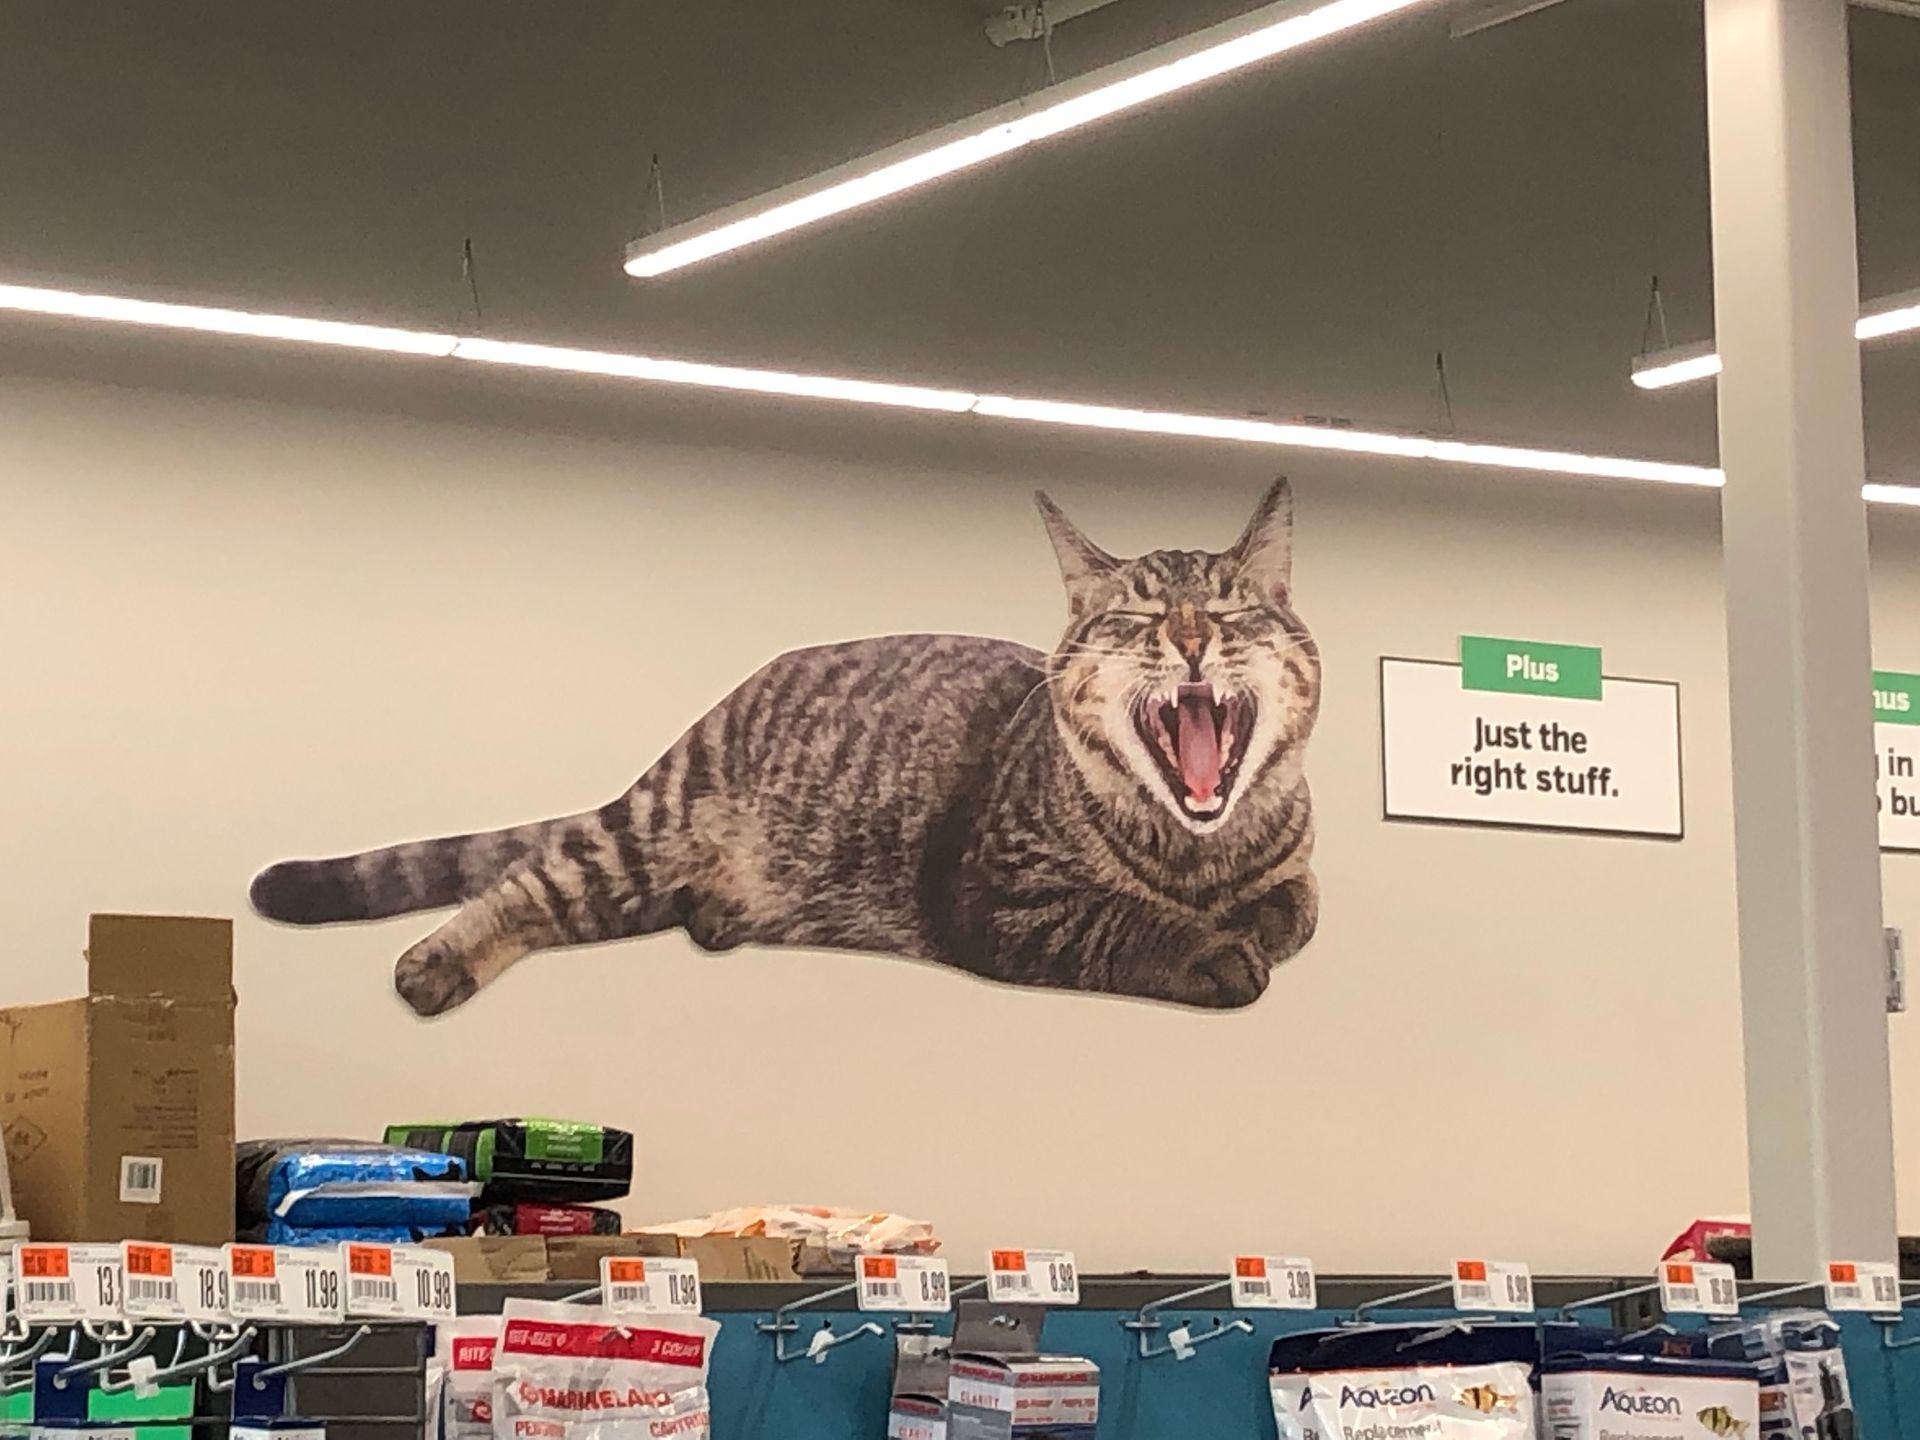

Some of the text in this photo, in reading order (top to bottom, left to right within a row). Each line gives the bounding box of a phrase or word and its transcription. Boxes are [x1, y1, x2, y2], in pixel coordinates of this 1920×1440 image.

[1506, 653, 1560, 682] Plus
[1474, 716, 1588, 754] Just the
[1451, 756, 1619, 797] right stuff.
[1888, 747, 1914, 777] in
[1891, 786, 1920, 817] bu
[199, 1267, 229, 1310] 18.9
[305, 1268, 339, 1309] 11.98
[417, 1268, 452, 1310] 10.98
